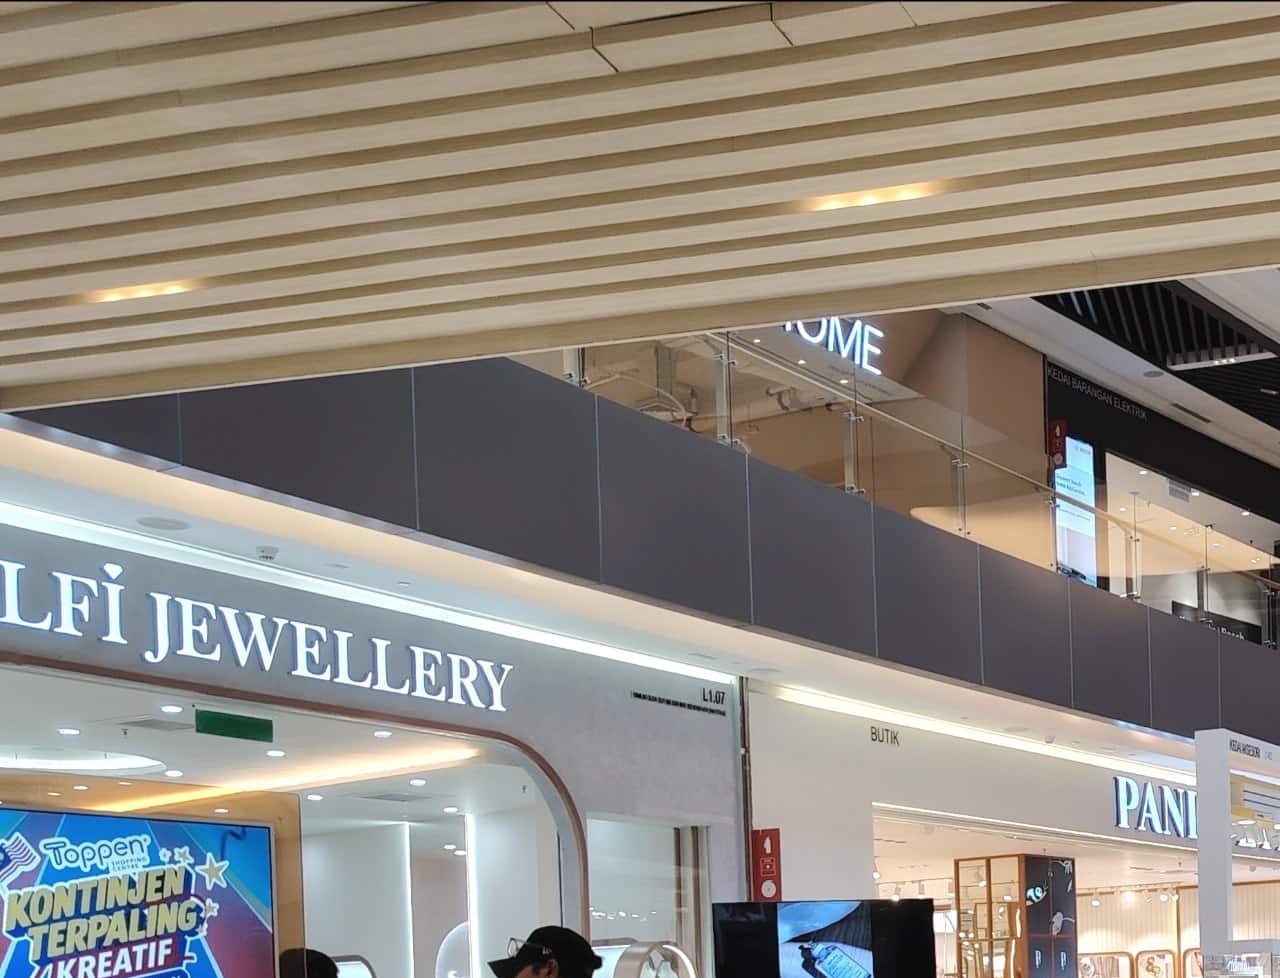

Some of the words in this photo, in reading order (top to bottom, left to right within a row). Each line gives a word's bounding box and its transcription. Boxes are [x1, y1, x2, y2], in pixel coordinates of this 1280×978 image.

[145, 592, 514, 713] JEWELLERY
[702, 687, 725, 705] L1.07
[870, 725, 900, 747] BUTIK
[43, 839, 145, 869] Toppen
[5, 865, 188, 931] KONTINJEN
[29, 899, 198, 961] TERPALING
